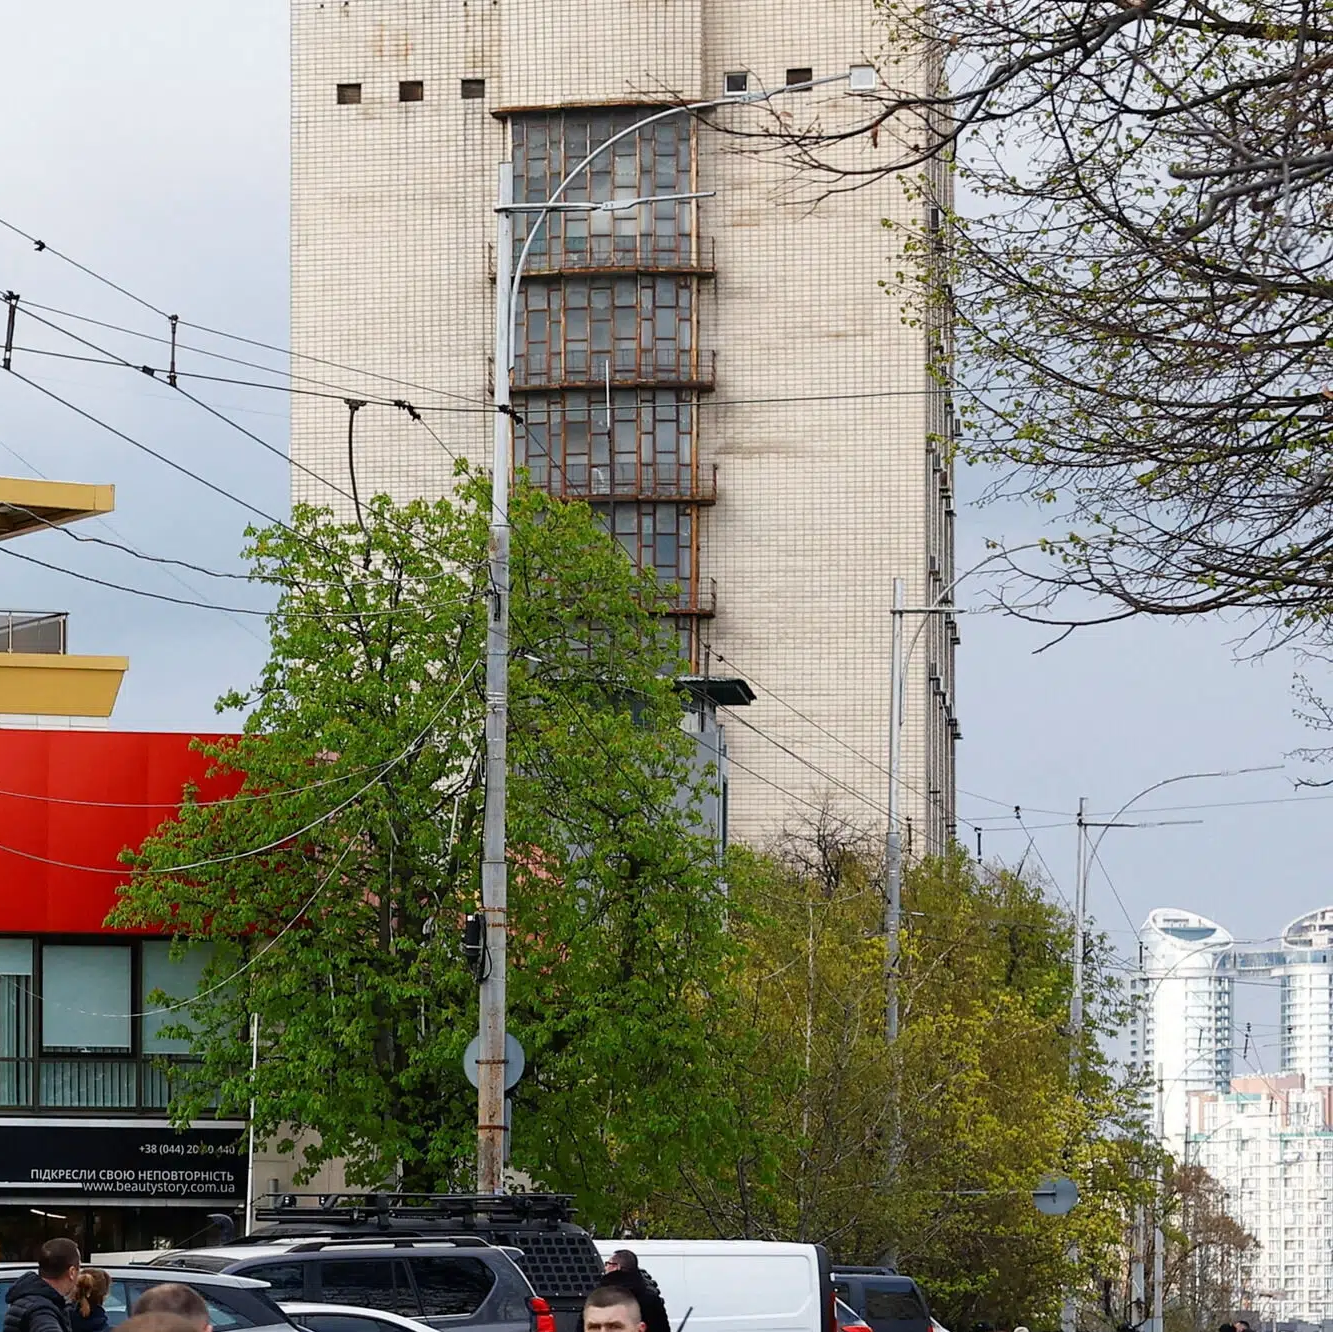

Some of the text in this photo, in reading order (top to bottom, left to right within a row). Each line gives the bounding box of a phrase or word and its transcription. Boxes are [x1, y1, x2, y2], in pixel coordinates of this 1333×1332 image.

[139, 1143, 157, 1155] +38
[159, 1143, 185, 1156] (044)
[30, 1168, 234, 1182] ПІДКРЕСЛИ СВОЮ НЕПОВТОРНІСТЬ
[82, 1181, 236, 1196] www.beautystory.com.ua
